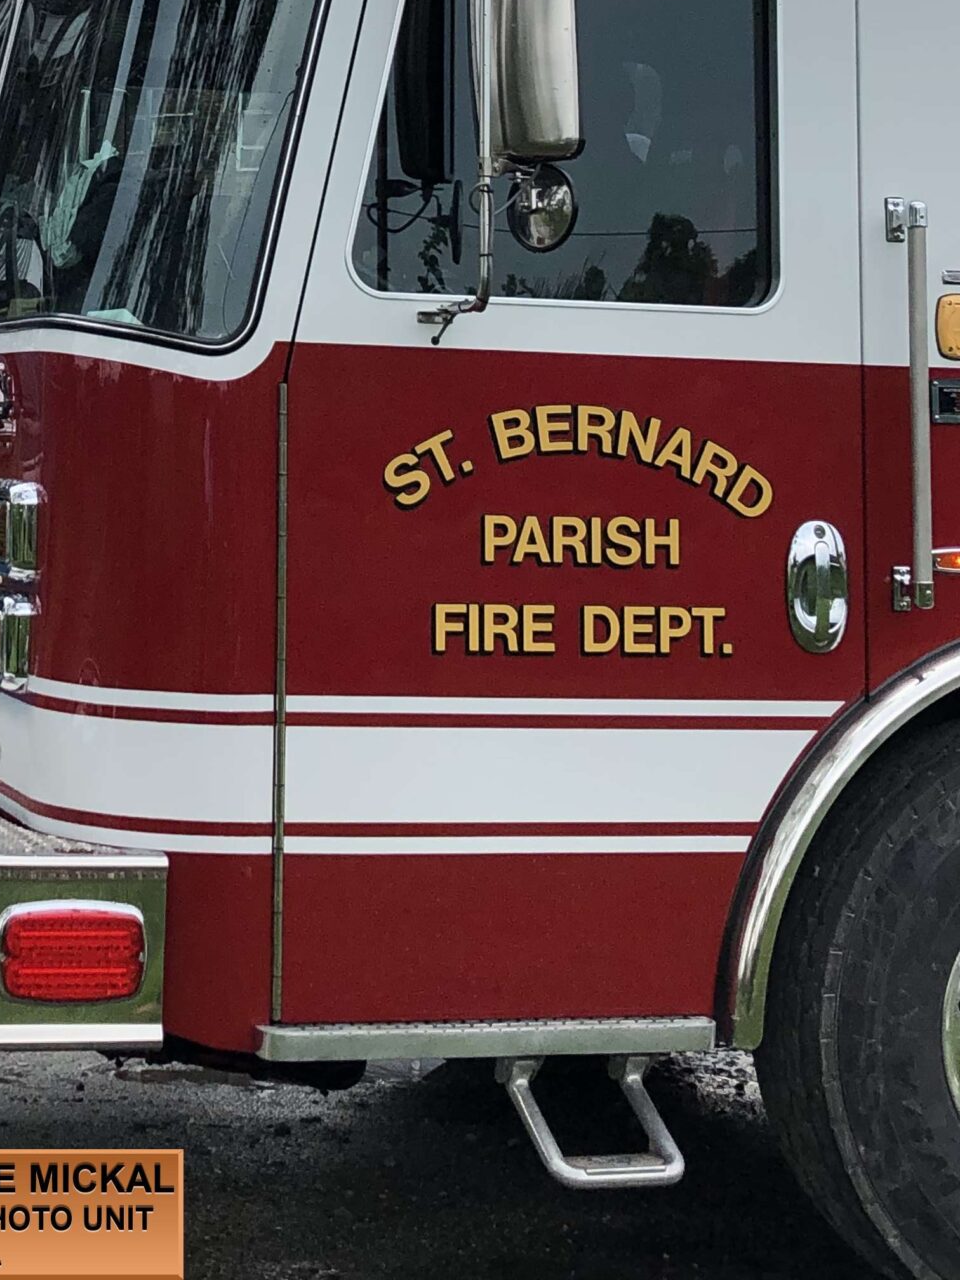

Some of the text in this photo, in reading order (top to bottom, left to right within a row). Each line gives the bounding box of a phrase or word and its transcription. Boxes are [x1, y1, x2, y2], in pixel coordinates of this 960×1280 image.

[383, 404, 774, 518] ST. BERNARD
[482, 514, 681, 565] PARISH
[433, 602, 734, 655] FIRE DEPT.
